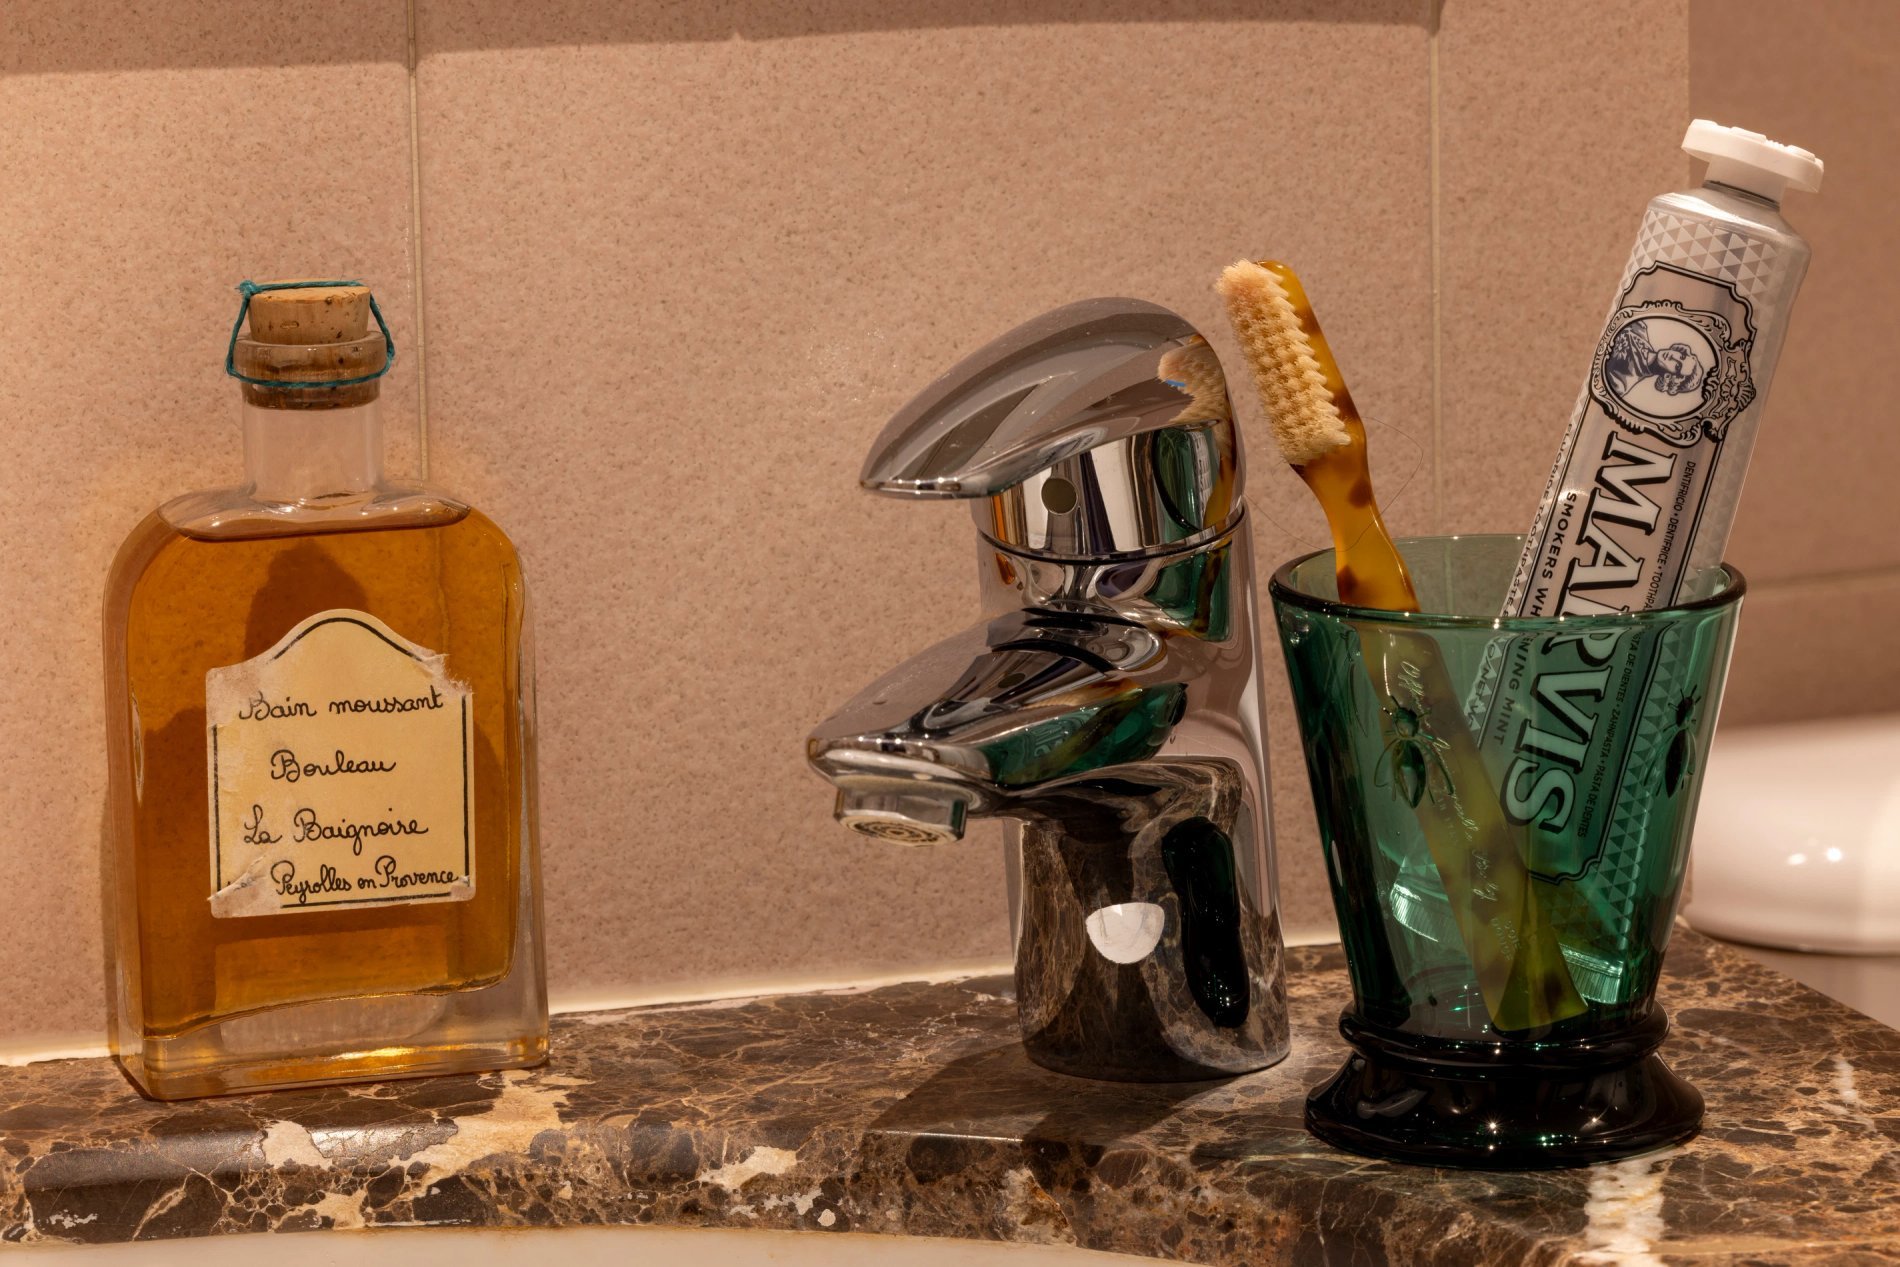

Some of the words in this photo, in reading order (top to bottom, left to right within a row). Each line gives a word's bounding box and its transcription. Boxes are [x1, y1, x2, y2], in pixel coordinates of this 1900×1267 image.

[1542, 422, 1573, 500] FLUORIDE
[1676, 460, 1696, 512] DENTIFRICIO
[1505, 503, 1545, 606] TOOTHPASTE
[1541, 491, 1577, 580] SMOKERS
[1656, 516, 1679, 565] DENTIFRICE
[1642, 570, 1663, 610] TOOTHPA
[1499, 431, 1678, 835] MARVIS
[238, 690, 318, 722] Bain
[328, 684, 444, 715] moussant
[1614, 666, 1633, 703] DIENTES
[1491, 696, 1515, 745] MINT
[1599, 708, 1621, 759] ZAHNPASTA
[270, 749, 397, 783] Bouleau
[1589, 764, 1606, 792] PASTA
[1576, 804, 1594, 839] DENTES
[1586, 792, 1598, 806] DE
[243, 804, 283, 845] La
[293, 807, 429, 857] Baignoire
[270, 859, 352, 904] Peyrolles
[357, 875, 378, 890] en
[374, 855, 460, 889] Provence
